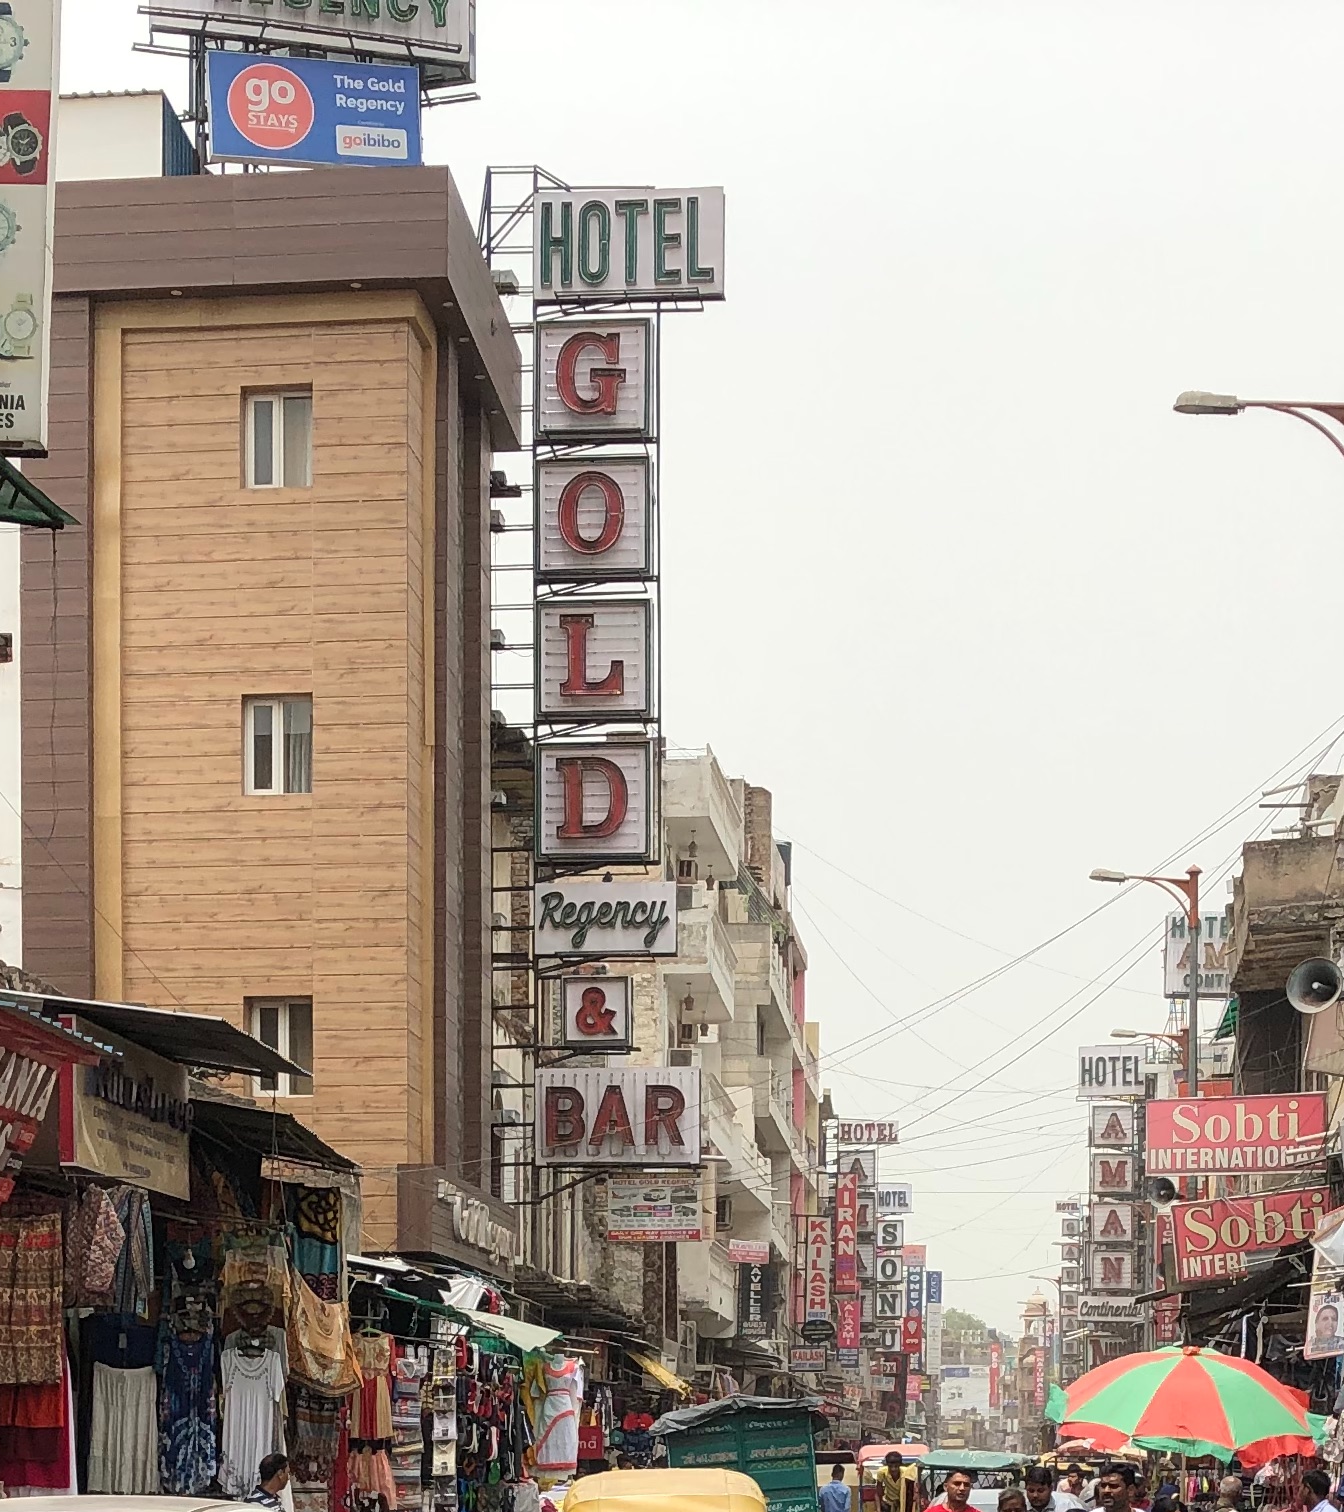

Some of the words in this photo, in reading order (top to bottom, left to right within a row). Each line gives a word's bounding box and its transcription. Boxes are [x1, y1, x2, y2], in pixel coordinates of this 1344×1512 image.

[245, 76, 296, 111] go
[333, 74, 364, 90] The
[368, 77, 406, 94] Gold
[336, 95, 405, 116] Regency
[247, 112, 299, 129] STAYS
[342, 134, 401, 150] goibibo
[540, 196, 715, 287] HOTEL
[556, 332, 629, 839] GOLD
[539, 891, 670, 949] Regency
[575, 986, 618, 1036] &
[1081, 1055, 1145, 1087] HOTEL
[545, 1084, 686, 1148] BAR
[839, 1123, 899, 1142] HOTEL
[1172, 1100, 1299, 1144] Sobti
[837, 1174, 855, 1256] KIRAN
[878, 1190, 909, 1208] HOTEL
[1099, 1112, 1128, 1284] AMAN
[1183, 1192, 1324, 1253] Sobti
[809, 1220, 828, 1310] KAILASH
[878, 1223, 899, 1350] SONU
[909, 1266, 921, 1307] MONEY
[749, 1263, 762, 1321] AVELLER
[1080, 1299, 1143, 1317] Continental
[842, 1300, 855, 1345] ALAXMI
